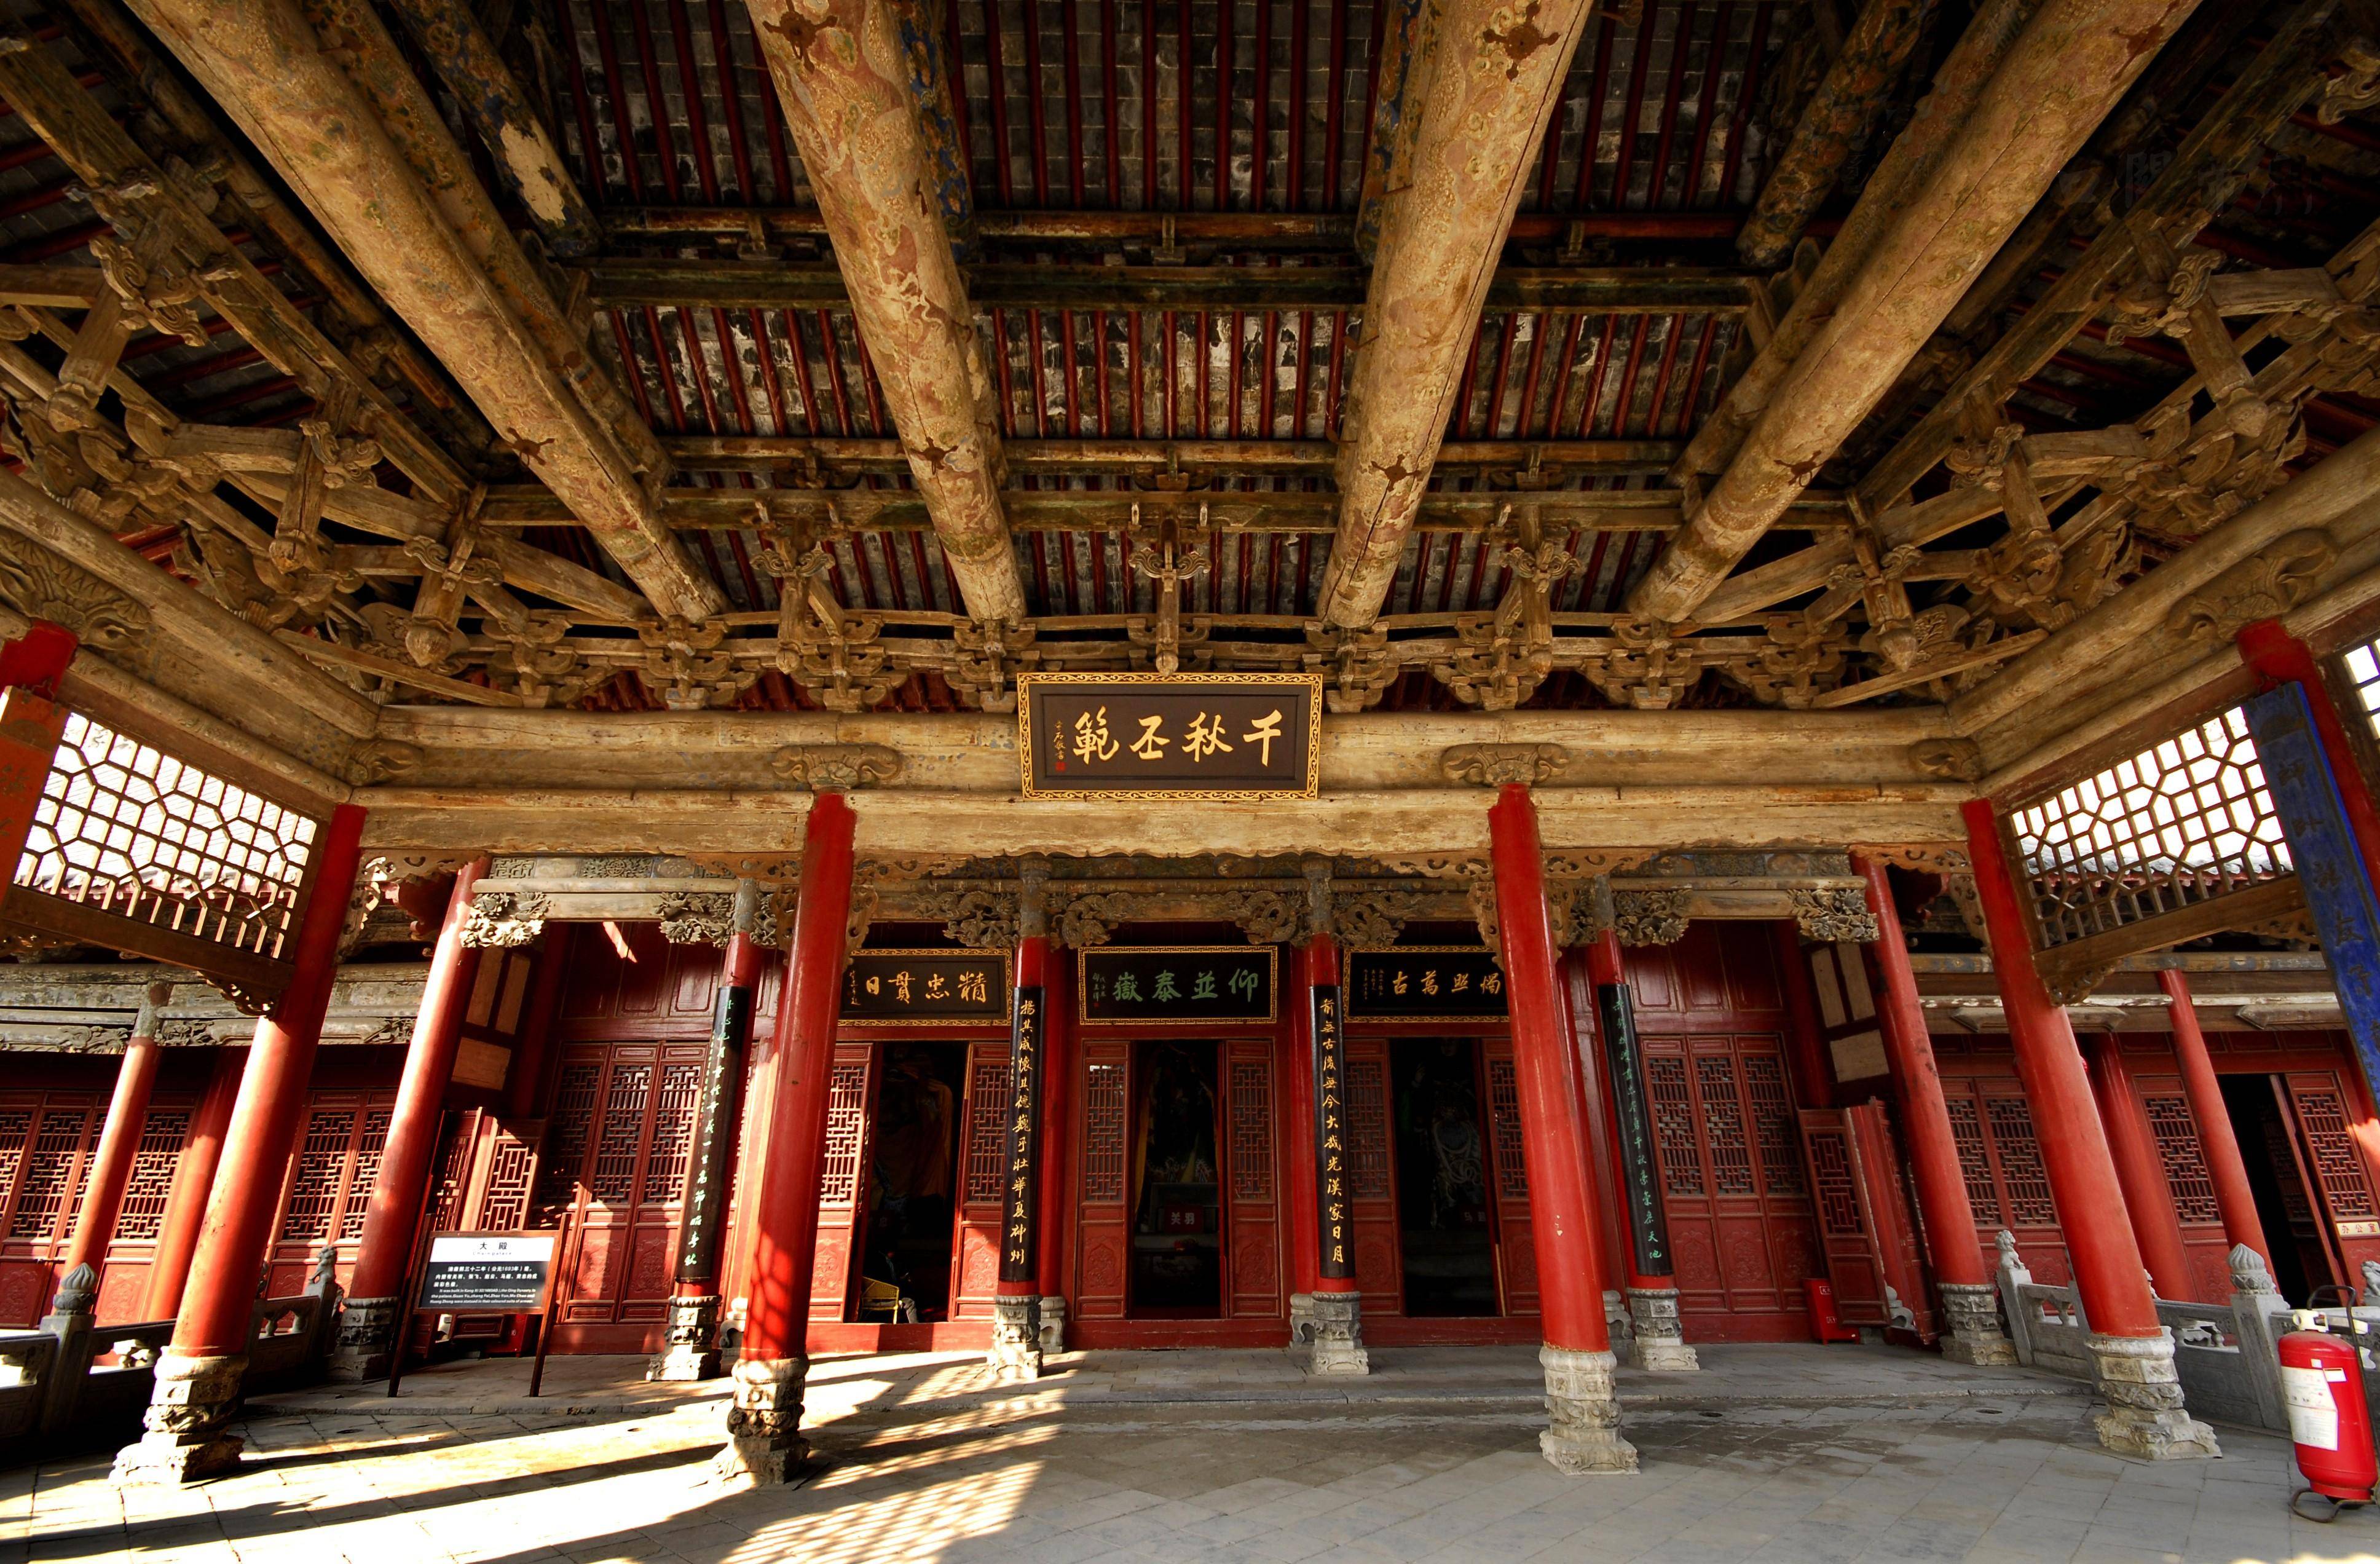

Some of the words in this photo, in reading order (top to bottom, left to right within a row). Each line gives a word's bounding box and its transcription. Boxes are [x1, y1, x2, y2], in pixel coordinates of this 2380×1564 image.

[1072, 705, 1283, 767] 千秋丕範
[866, 971, 987, 1005] 精忠貫日
[1170, 1212, 1195, 1225] 关羽
[2341, 1223, 2377, 1233] 办公室
